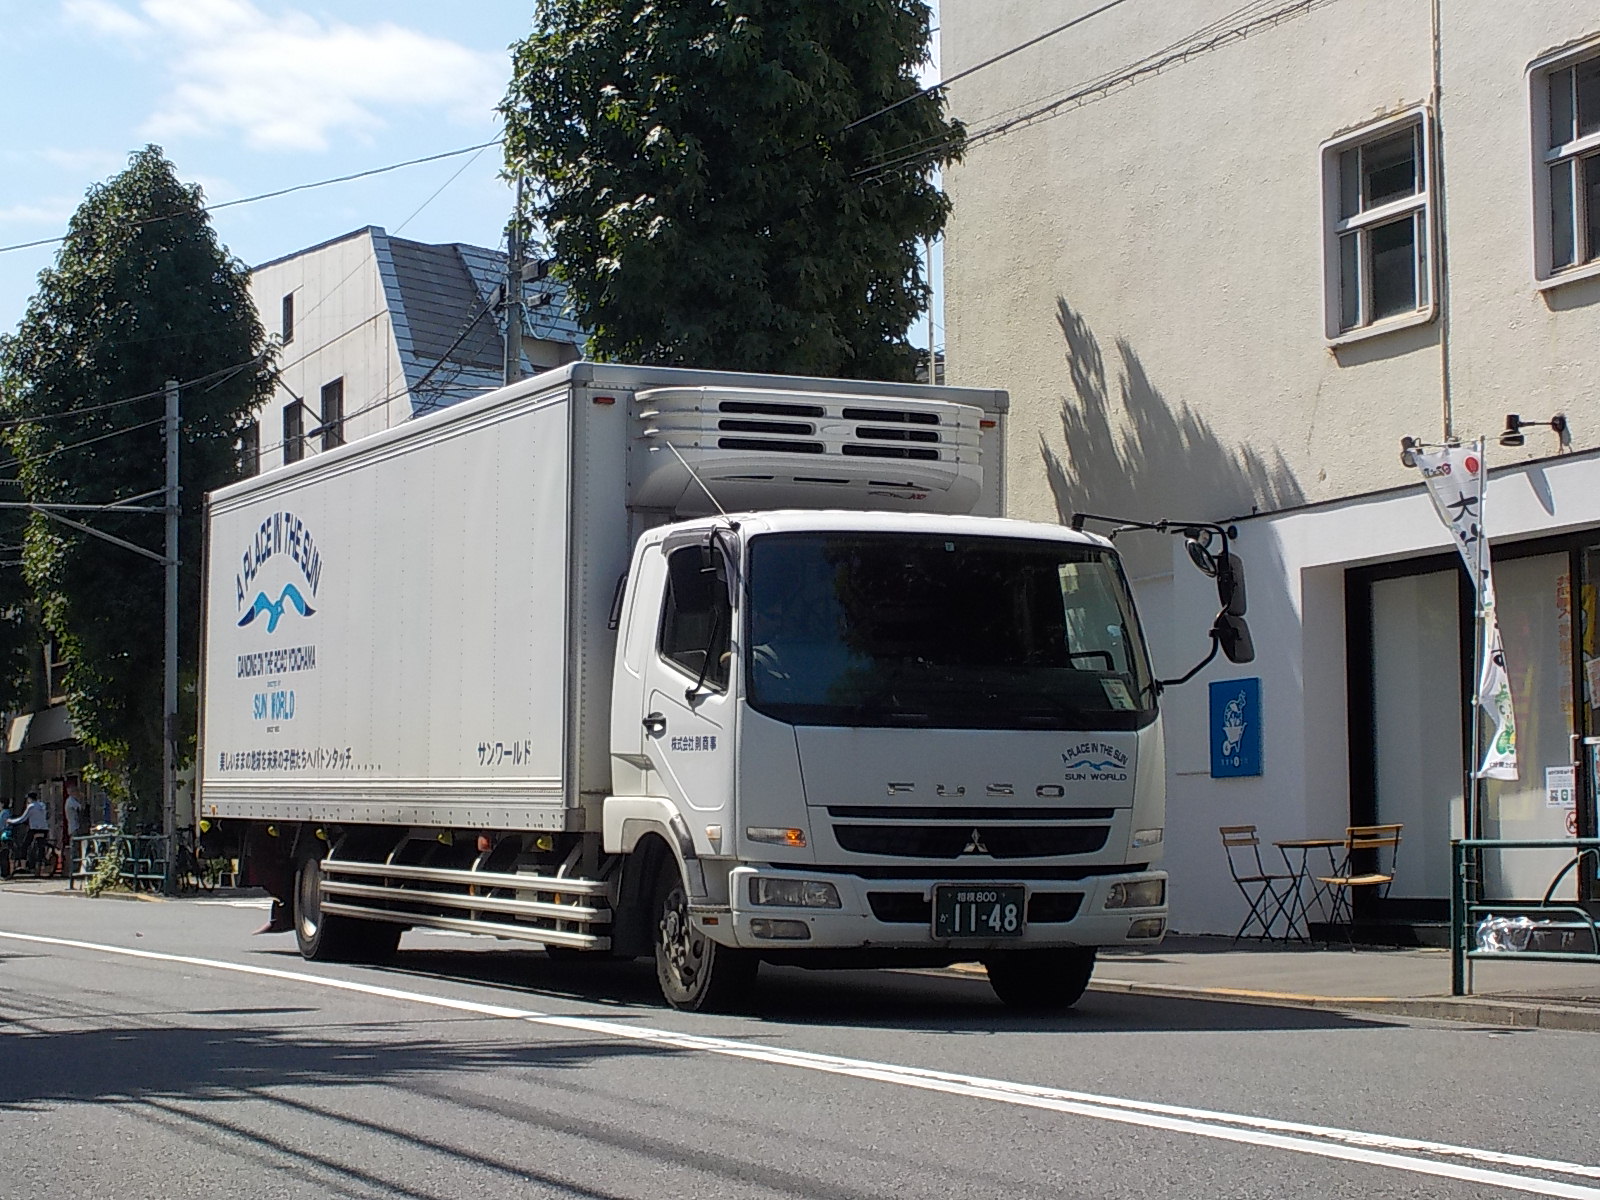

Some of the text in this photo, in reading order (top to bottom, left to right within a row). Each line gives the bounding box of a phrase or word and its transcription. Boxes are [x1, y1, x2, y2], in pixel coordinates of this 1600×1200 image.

[236, 511, 322, 613] A PLACE IN THE SUN
[253, 690, 295, 720] SUN WORLD
[477, 740, 532, 767] サンワールド
[1061, 742, 1129, 766] A PLACE IN THE SUN
[887, 782, 1065, 798] FUSO
[1064, 773, 1128, 781] SUN WORLD
[954, 903, 1018, 932] 11-48
